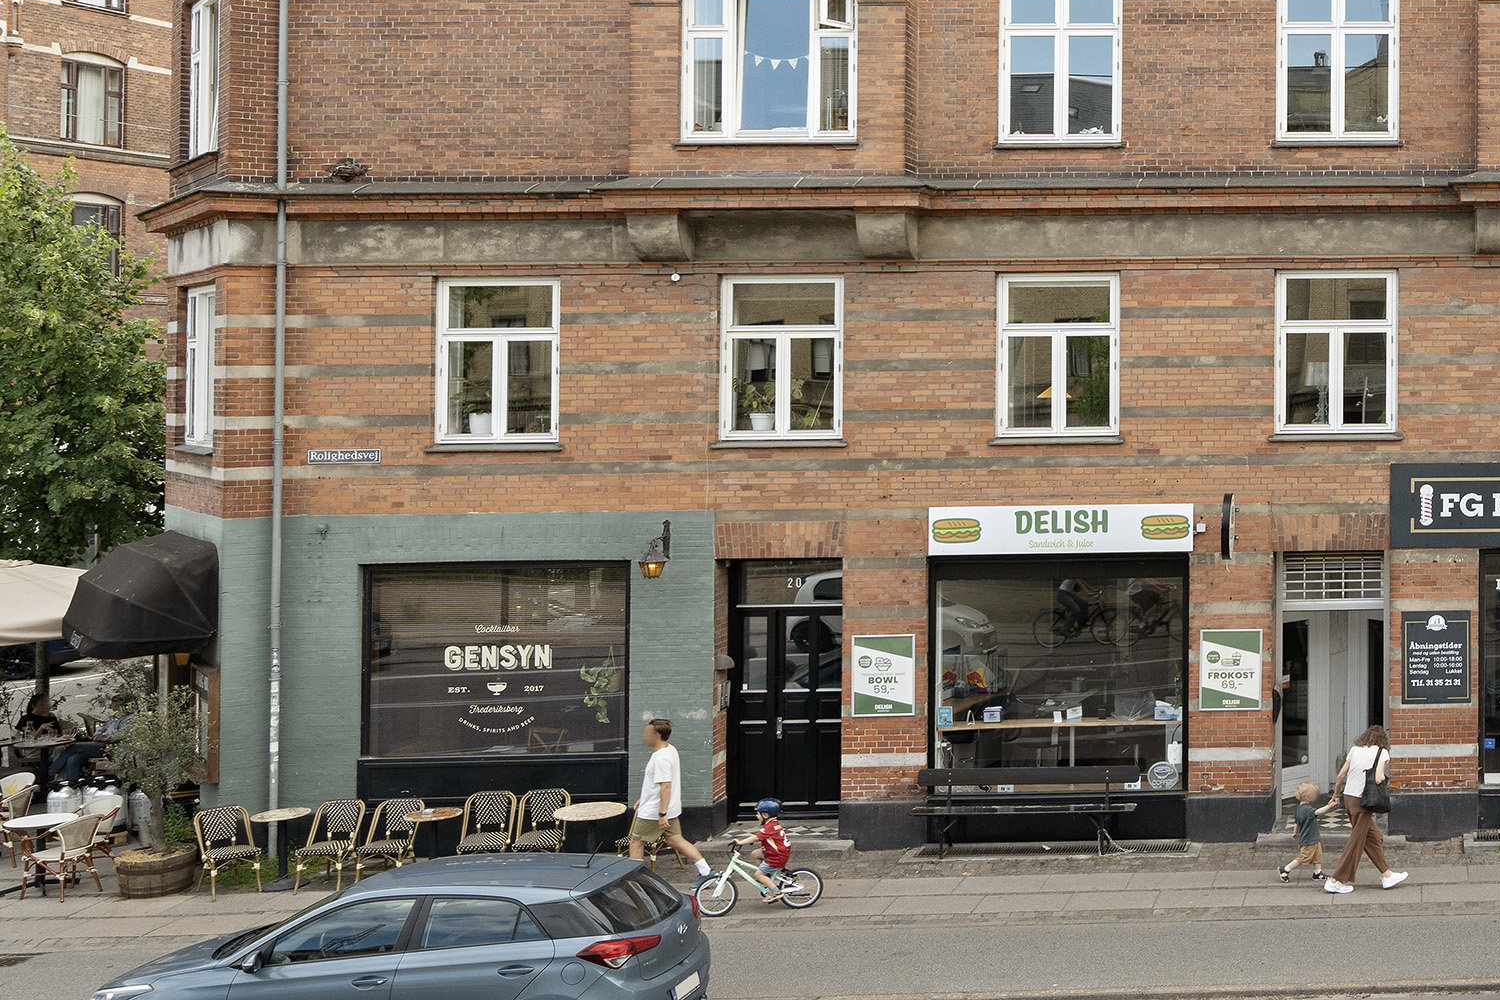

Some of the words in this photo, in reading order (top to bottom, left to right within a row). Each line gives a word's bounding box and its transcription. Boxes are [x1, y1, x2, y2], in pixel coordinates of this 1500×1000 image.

[310, 450, 379, 462] Rolighedsvej
[1440, 492, 1484, 517] FG
[1014, 509, 1109, 534] DELISH
[1029, 539, 1065, 548] Sandwich
[1067, 539, 1074, 548] &
[1075, 539, 1094, 548] Juice
[474, 624, 521, 633] Cocktailbar
[1409, 641, 1463, 650] Åbningstider
[444, 644, 553, 671] GENSYN
[868, 676, 899, 684] BOWL
[1208, 671, 1255, 679] FROKOST
[469, 704, 525, 714] Frederiksberg
[507, 724, 520, 732] AND
[520, 716, 536, 727] BEER
